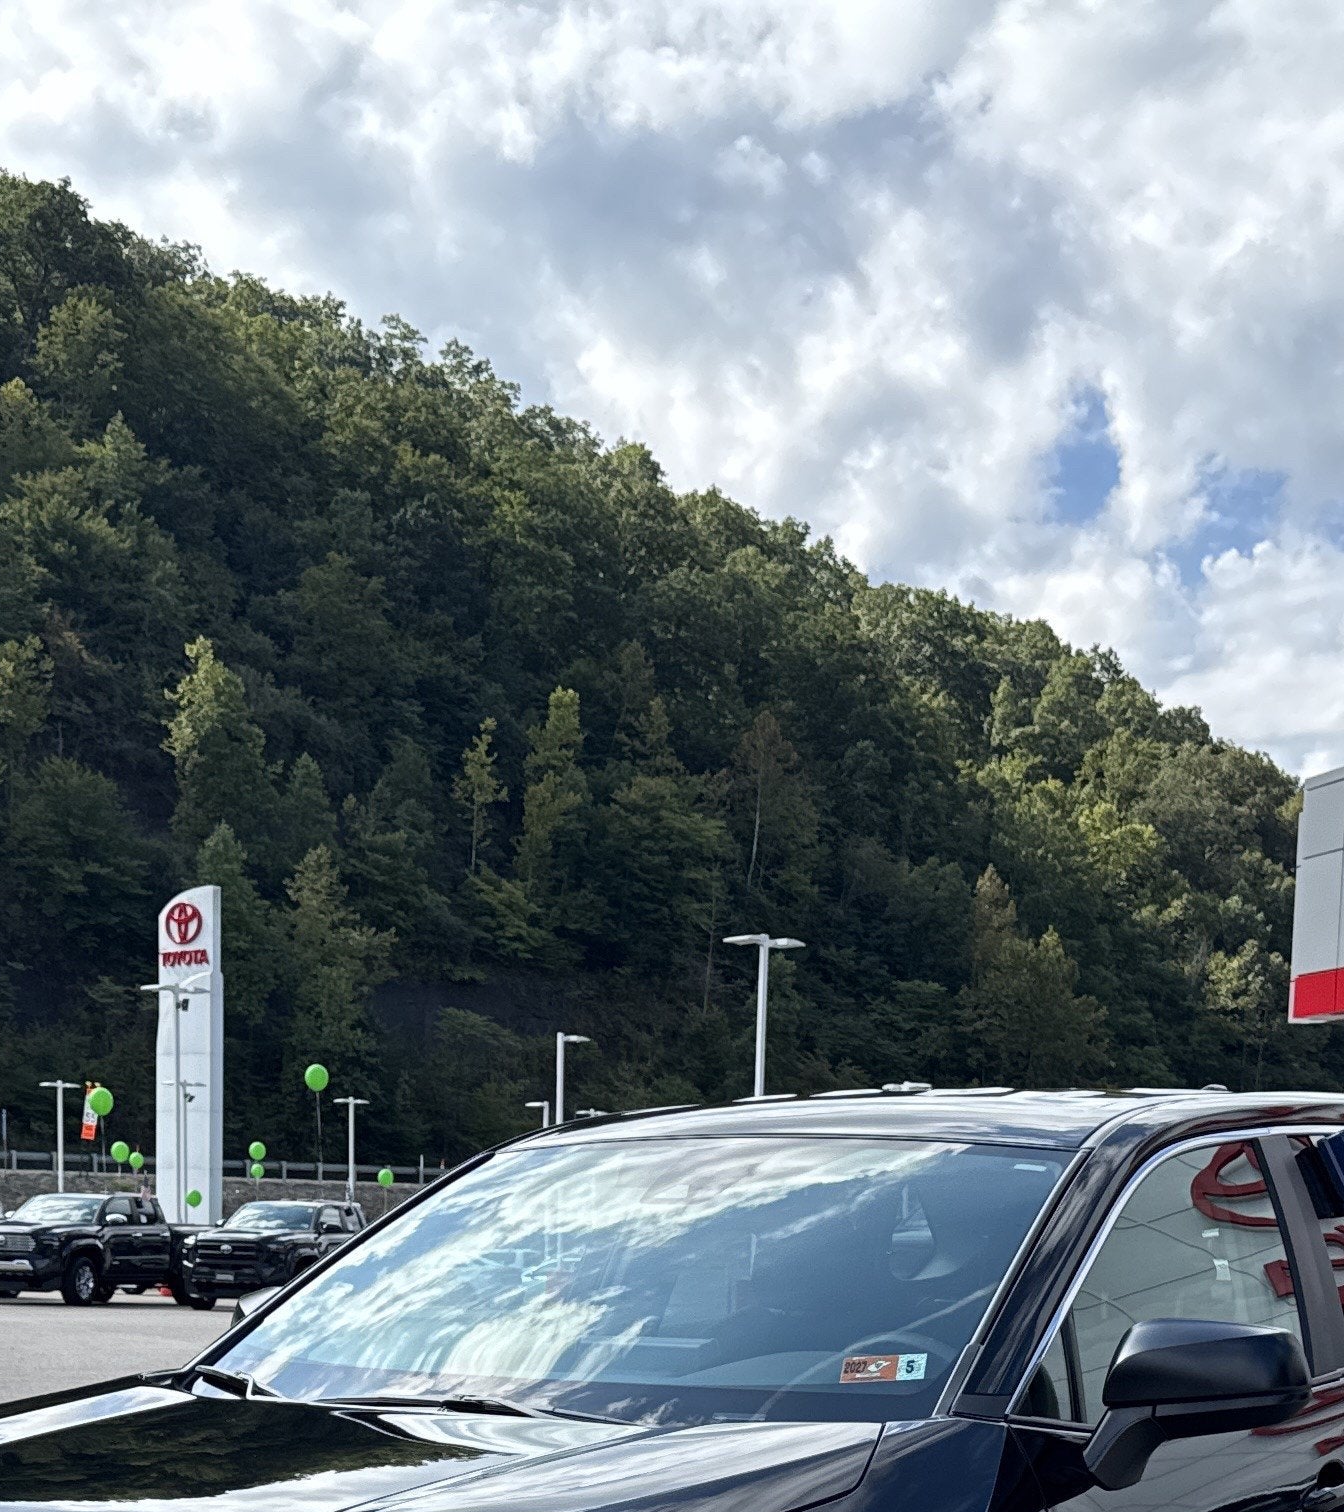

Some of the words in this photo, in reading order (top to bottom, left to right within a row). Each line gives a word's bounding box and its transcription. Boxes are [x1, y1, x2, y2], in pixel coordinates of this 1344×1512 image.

[161, 949, 210, 968] TOYOTA
[843, 1360, 868, 1374] 2027
[905, 1360, 916, 1374] 5
